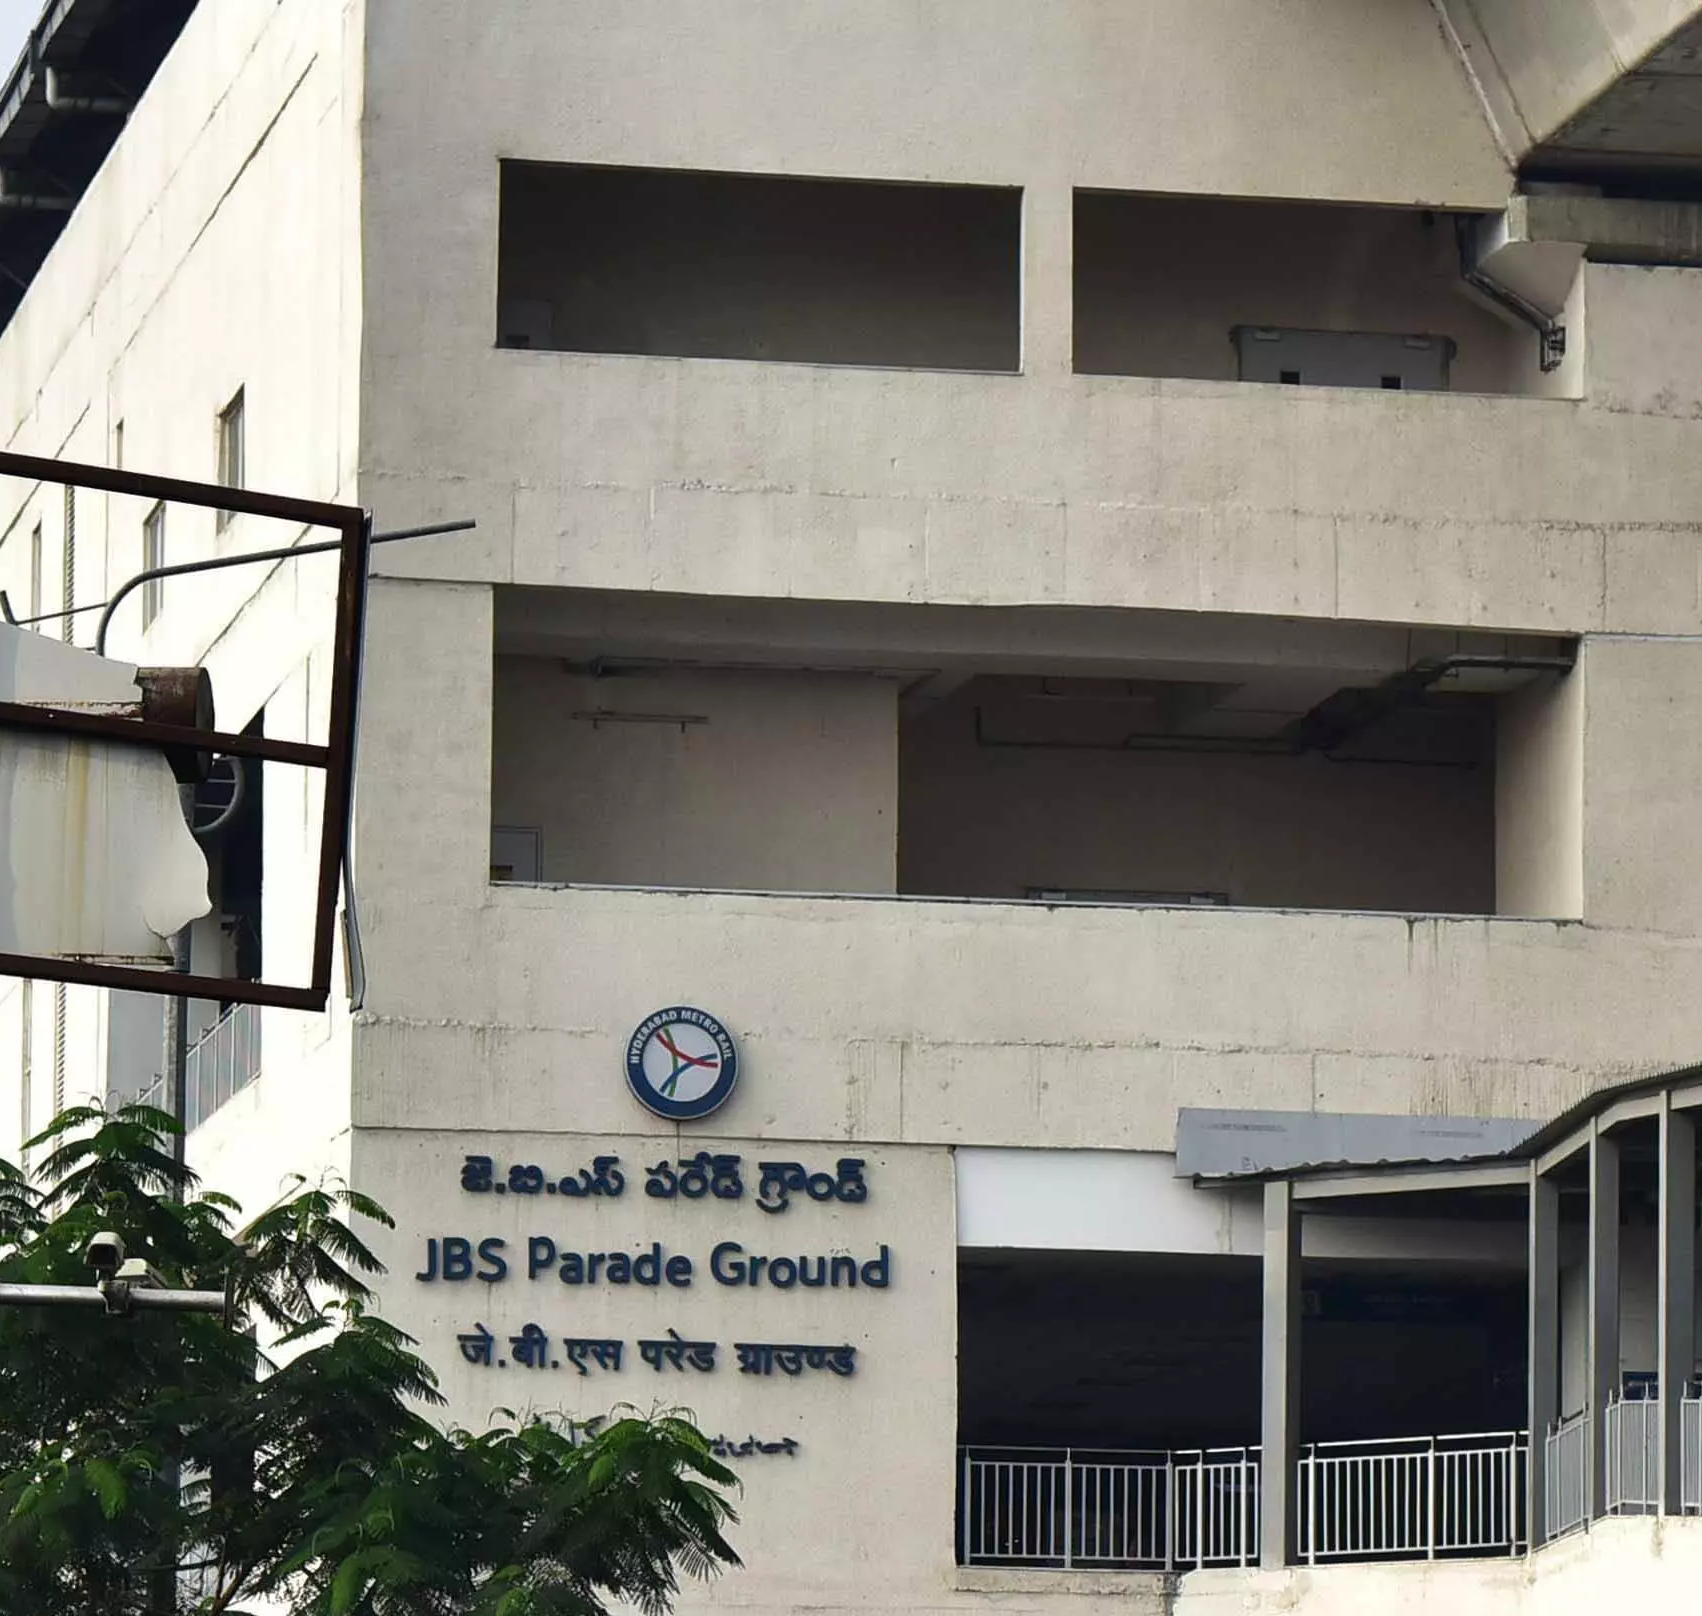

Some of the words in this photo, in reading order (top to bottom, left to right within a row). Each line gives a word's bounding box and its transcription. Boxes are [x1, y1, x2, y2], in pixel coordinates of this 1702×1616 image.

[630, 1009, 678, 1065] HYDERABAD
[681, 1009, 720, 1035] METRO
[715, 1033, 733, 1060] RAIL
[416, 1237, 508, 1286] JBS
[528, 1236, 693, 1288] Parade
[710, 1241, 890, 1290] Ground
[457, 1322, 624, 1377] जे.बी.एस
[637, 1327, 717, 1373] परेड
